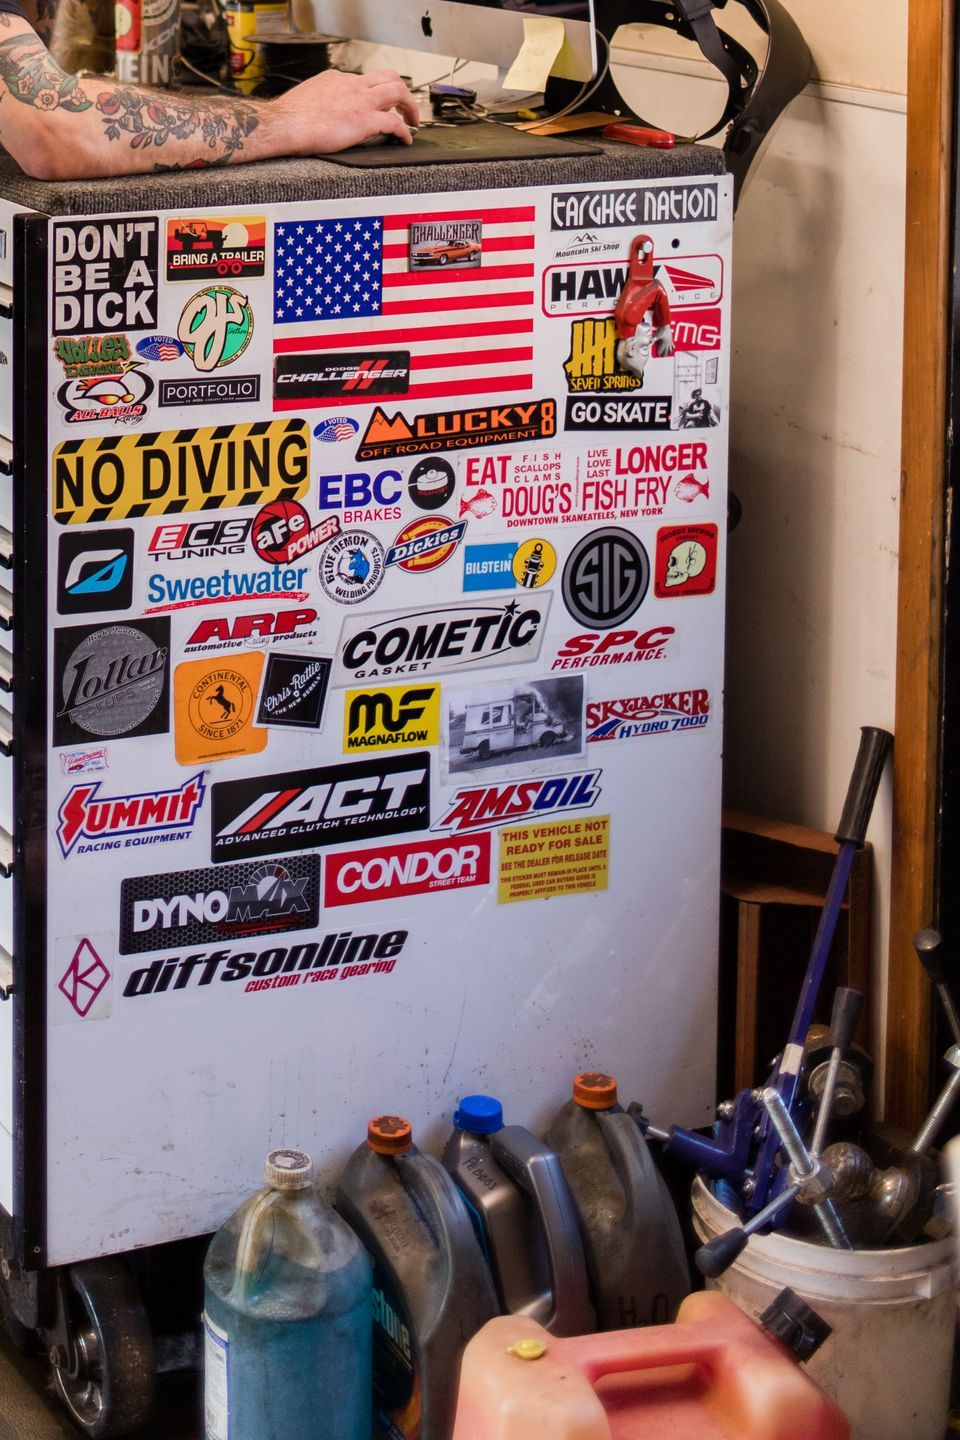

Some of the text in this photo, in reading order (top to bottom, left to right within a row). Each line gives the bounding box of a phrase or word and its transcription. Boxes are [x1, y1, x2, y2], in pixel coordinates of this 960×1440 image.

[552, 187, 716, 227] TARGHEE NATION
[55, 222, 155, 262] DON'T
[412, 223, 479, 245] CHALLENGER
[173, 250, 264, 266] BRING A TRAILER
[555, 243, 620, 258] Mountain Ski Shop
[55, 260, 154, 293] BE A
[55, 289, 155, 330] DICK
[152, 336, 174, 344] VOTED
[277, 368, 408, 383] CHALLENGER
[570, 375, 641, 391] SEVEN SPRINGS
[167, 382, 252, 399] PORTFOLIO
[69, 405, 143, 421] ALL BALLS
[114, 415, 143, 425] Racing
[417, 401, 554, 437] LUCKY 8
[571, 402, 668, 423] GO SKATE
[360, 429, 538, 458] OFF ROAD EQUIPMENT
[587, 449, 608, 458] LIVE
[56, 434, 308, 509] NO DIVING
[466, 455, 512, 486] EAT
[514, 462, 561, 473] SCALLOPS
[523, 453, 561, 463] FISH
[587, 459, 611, 468] LOVE
[615, 442, 708, 475] LONGER
[514, 473, 561, 483] CLAMS
[587, 470, 610, 478] LAST
[319, 469, 403, 510] EBC
[501, 483, 572, 517] DOUG'S
[582, 479, 628, 510] FISH
[635, 475, 672, 507] FRY
[343, 507, 402, 523] BRAKES
[507, 507, 663, 527] DOWNTOWN SKANEATELES, NEW YORK
[150, 518, 252, 551] ECS
[256, 513, 306, 550] aFe
[287, 517, 339, 561] POWER
[391, 528, 460, 562] Dickies
[659, 528, 686, 542] VOODOO
[148, 544, 246, 562] TUNING
[324, 535, 369, 584] BLUE DEMON
[335, 547, 381, 599] WELDING PRODUCTS
[465, 560, 512, 575] BILSTEIN
[576, 542, 637, 614] SIG
[148, 565, 308, 603] Sweetwater
[186, 608, 318, 645] ARP
[342, 607, 541, 669] COMETIC
[184, 639, 243, 653] automotive
[272, 630, 317, 643] products
[557, 626, 676, 657] SPC
[354, 661, 431, 679] GASKET
[551, 648, 666, 670] PERFORMANCE
[193, 671, 249, 699] CONTINENTAL
[263, 662, 322, 712] Chris Rattie
[68, 687, 137, 724] PICKUPS
[288, 699, 302, 709] NEW
[348, 688, 436, 735] MF
[586, 688, 710, 729] SKYJACKER
[198, 718, 244, 739] SINCE 1871
[348, 730, 429, 748] MAGNAFLOW
[618, 714, 708, 739] HYDRO 7000
[261, 768, 427, 830] ACT
[440, 773, 595, 830] AMSOIL
[62, 782, 198, 846] SUMMIT
[215, 806, 426, 846] ADVANCED CLUTCH TECHNOLOGY
[77, 831, 193, 854] RACING EQUIPMENT
[502, 820, 608, 842] THIS VEHICLE NOT
[506, 835, 603, 856] READY FOR SALE
[336, 844, 480, 894] CONDOR
[501, 862, 512, 871] SEE
[514, 860, 526, 869] THE
[527, 857, 550, 868] DEALER
[565, 852, 591, 862] RELEASE
[592, 849, 607, 859] DATE
[428, 874, 476, 888] STREET TEAM
[133, 876, 311, 933] DYNOMAX
[122, 930, 409, 998] diffsonline
[244, 959, 398, 993] custom race gearing
